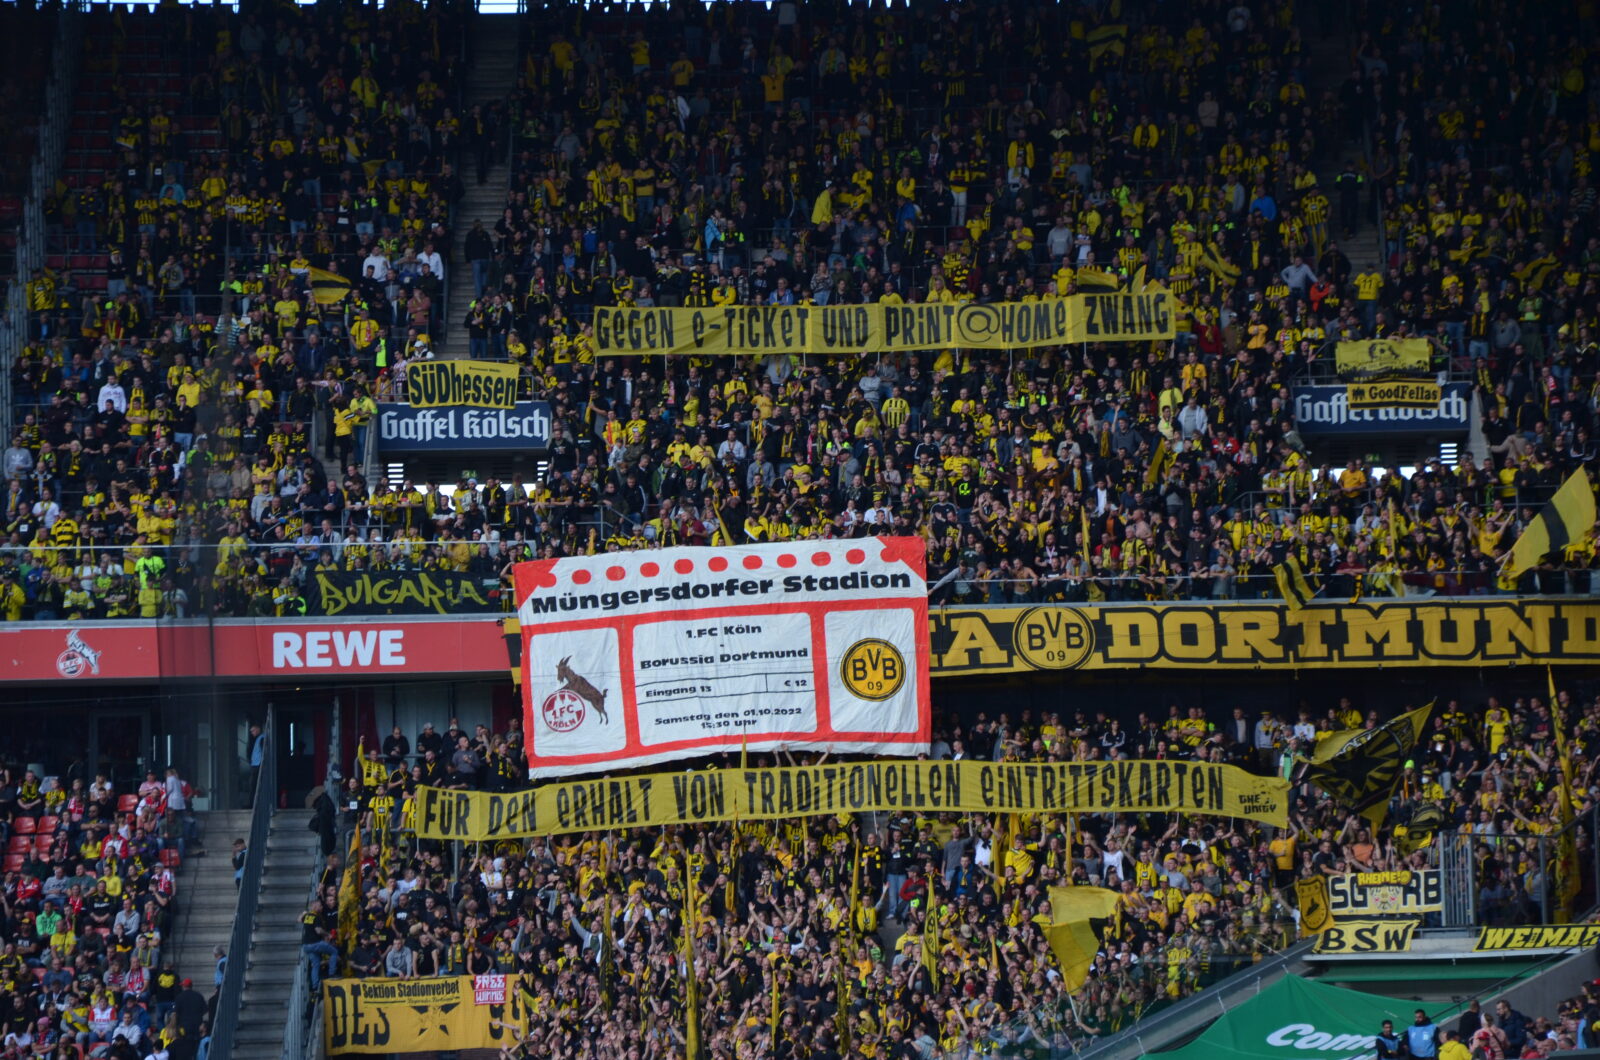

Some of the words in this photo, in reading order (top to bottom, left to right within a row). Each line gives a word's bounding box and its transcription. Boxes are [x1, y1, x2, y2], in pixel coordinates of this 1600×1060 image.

[823, 307, 868, 346] UND
[1085, 294, 1170, 335] ZWANG
[1369, 385, 1438, 400] GoodFellas
[381, 410, 459, 442] Gaffel
[463, 408, 549, 441] Kölsch
[532, 579, 773, 614] Müngersdorfer
[783, 571, 911, 592] Stadion
[686, 628, 718, 639] 1.FC
[724, 625, 762, 636] Köln
[1027, 612, 1084, 650] BVB
[1104, 604, 1600, 663] DORTMUND
[272, 630, 406, 668] REWE
[640, 654, 715, 670] Borussia
[720, 648, 808, 663] Dortmund
[1046, 650, 1066, 662] 09
[853, 648, 896, 681] BVB
[646, 686, 697, 698] Eingang
[867, 681, 882, 690] 09
[655, 713, 711, 726] Samstag
[715, 711, 739, 719] den
[743, 707, 802, 718] 01.10.2022
[701, 721, 730, 730] 15:30
[734, 719, 757, 728] Uhr
[424, 789, 470, 835] FÜR
[673, 772, 725, 820] VON
[1331, 876, 1368, 909] SG
[1320, 924, 1413, 951] BSW
[362, 984, 397, 998] Sektion
[475, 975, 505, 989] FREE
